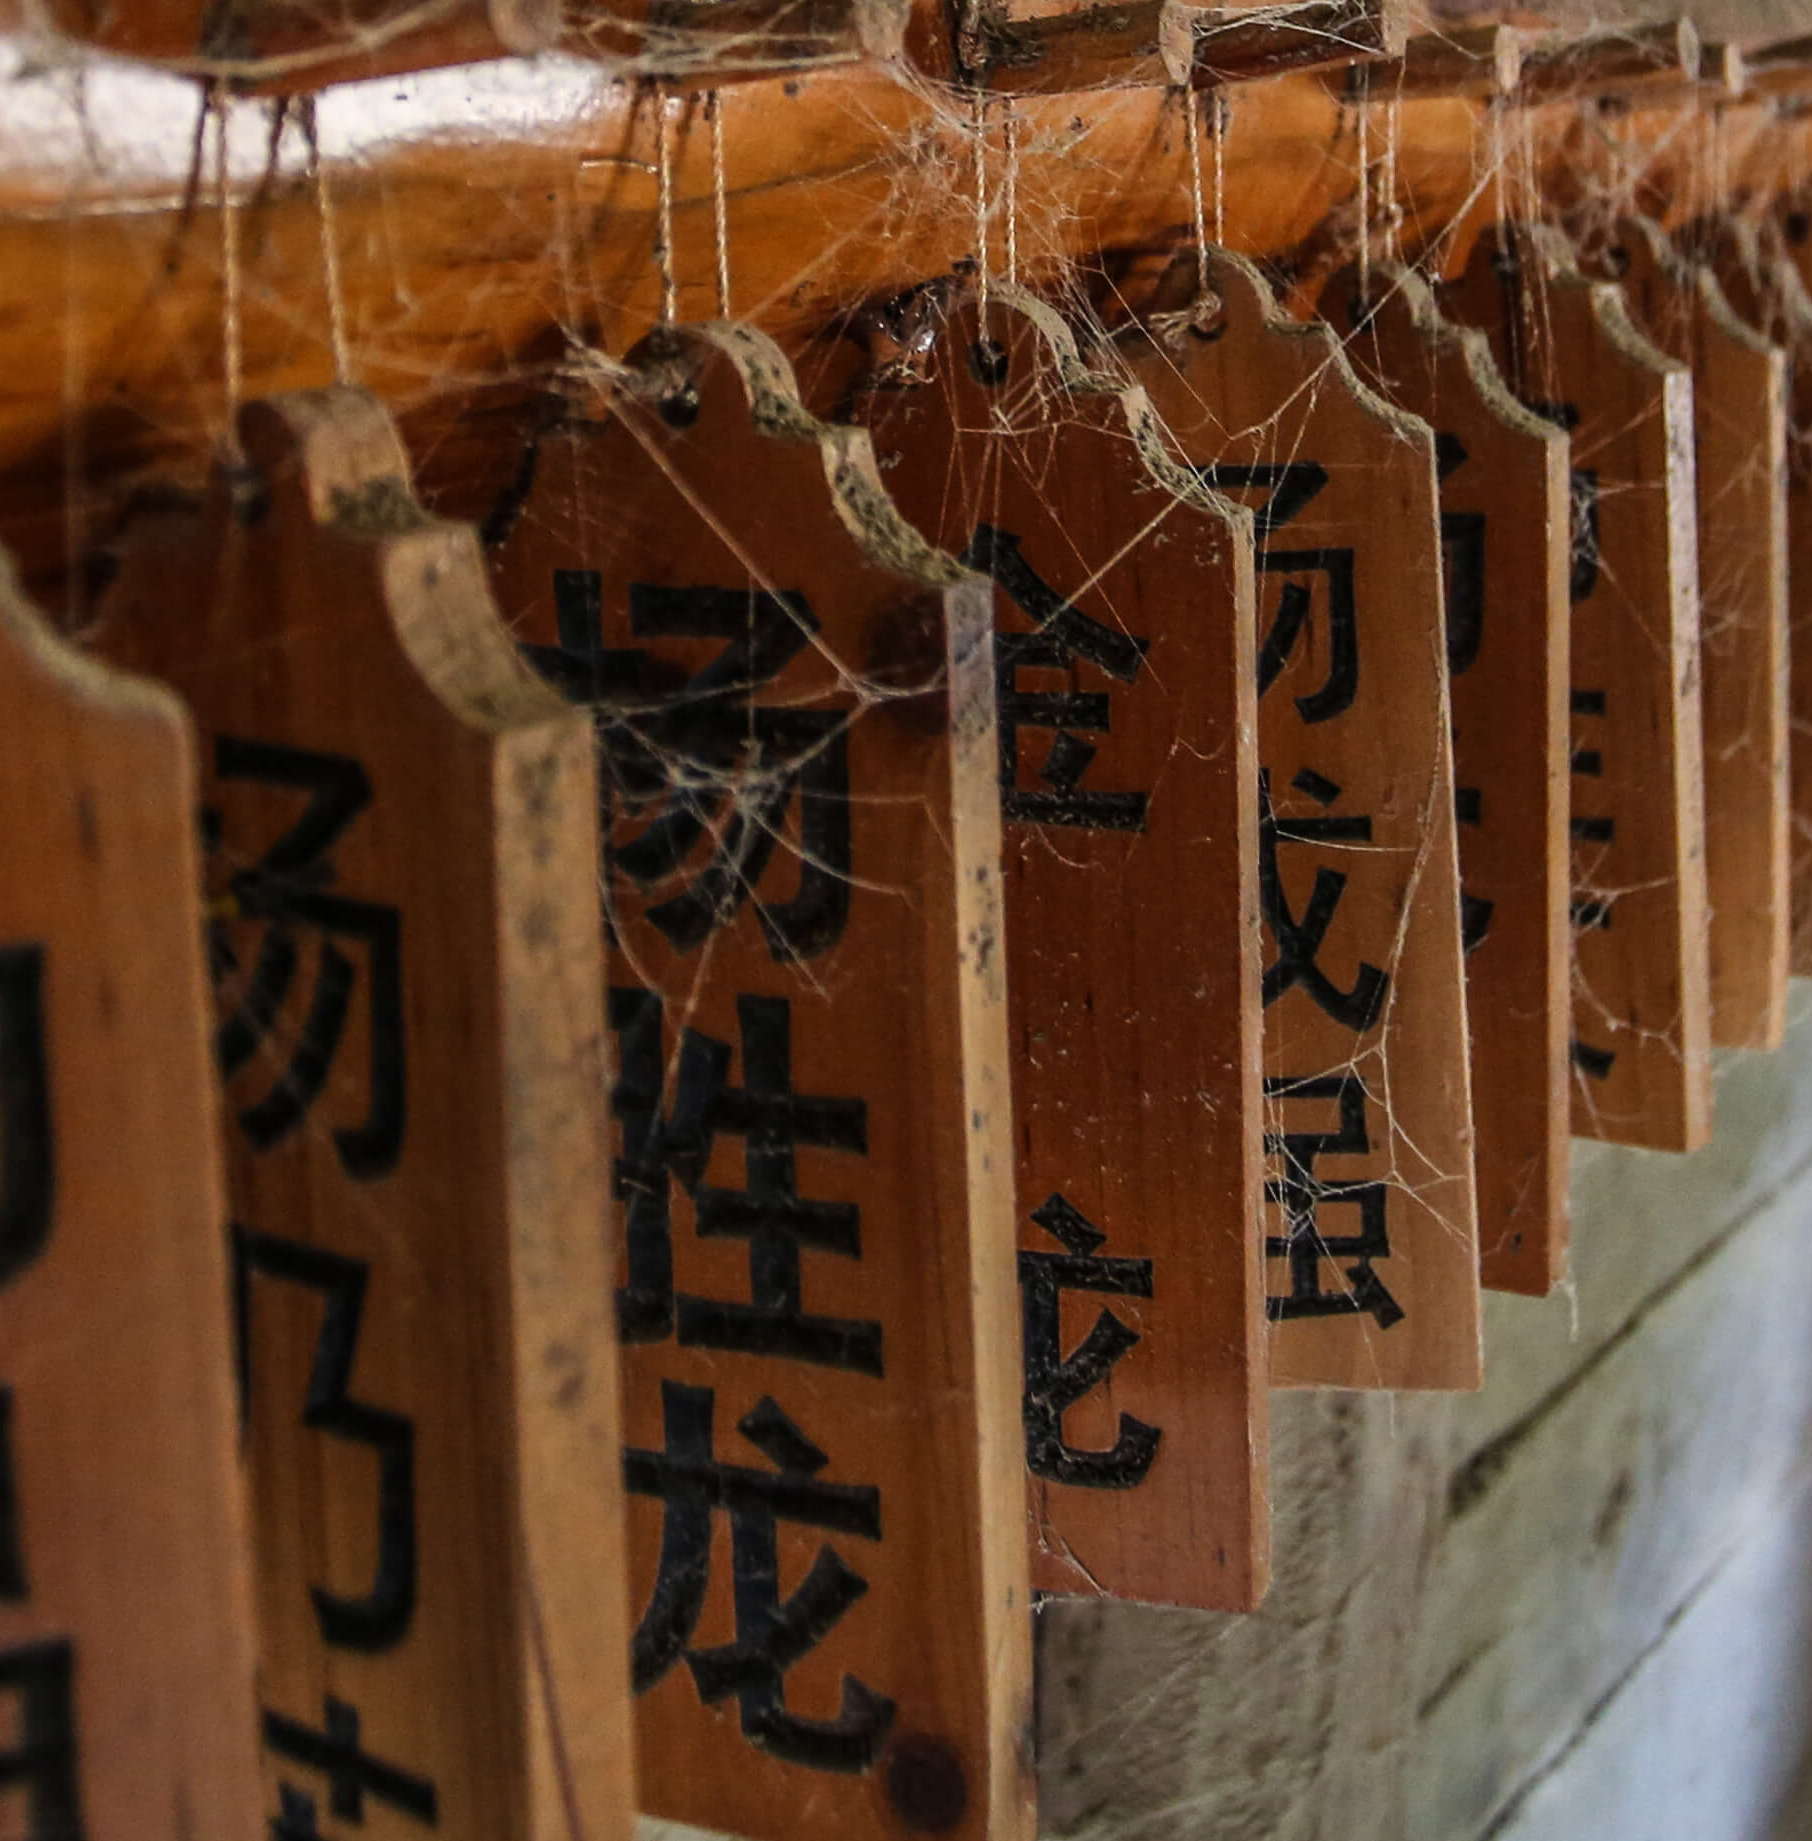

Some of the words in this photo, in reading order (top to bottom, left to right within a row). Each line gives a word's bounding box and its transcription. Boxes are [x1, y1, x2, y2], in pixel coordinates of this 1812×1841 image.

[199, 735, 441, 1841] 杨乃
[515, 566, 900, 1780] 杨胜龙
